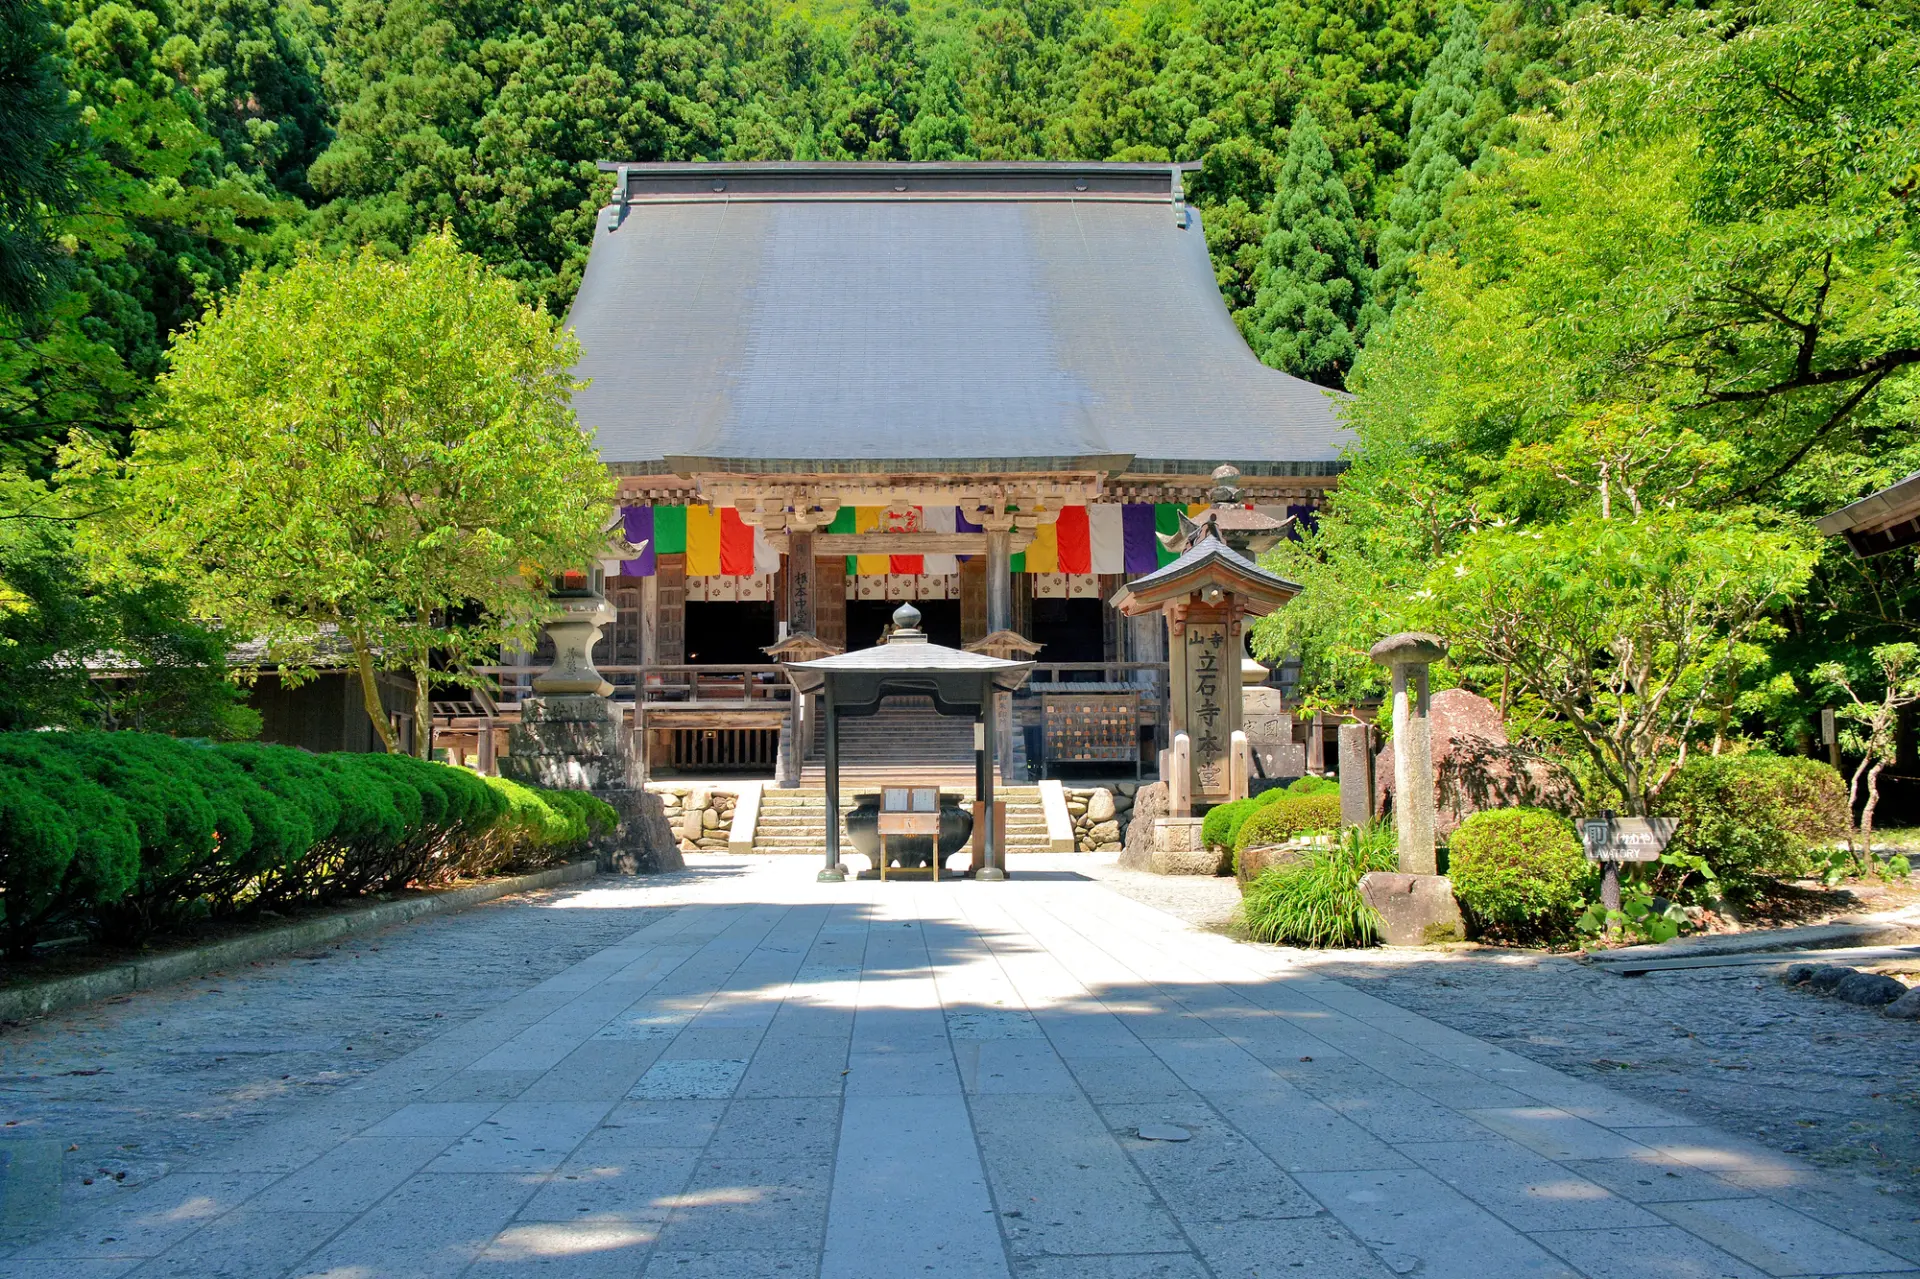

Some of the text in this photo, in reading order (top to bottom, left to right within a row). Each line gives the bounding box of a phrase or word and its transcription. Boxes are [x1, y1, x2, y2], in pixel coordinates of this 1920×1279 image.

[1188, 630, 1224, 649] 山寺
[1195, 650, 1222, 788] 立石寺本堂
[1589, 848, 1641, 859] LAVATORY
